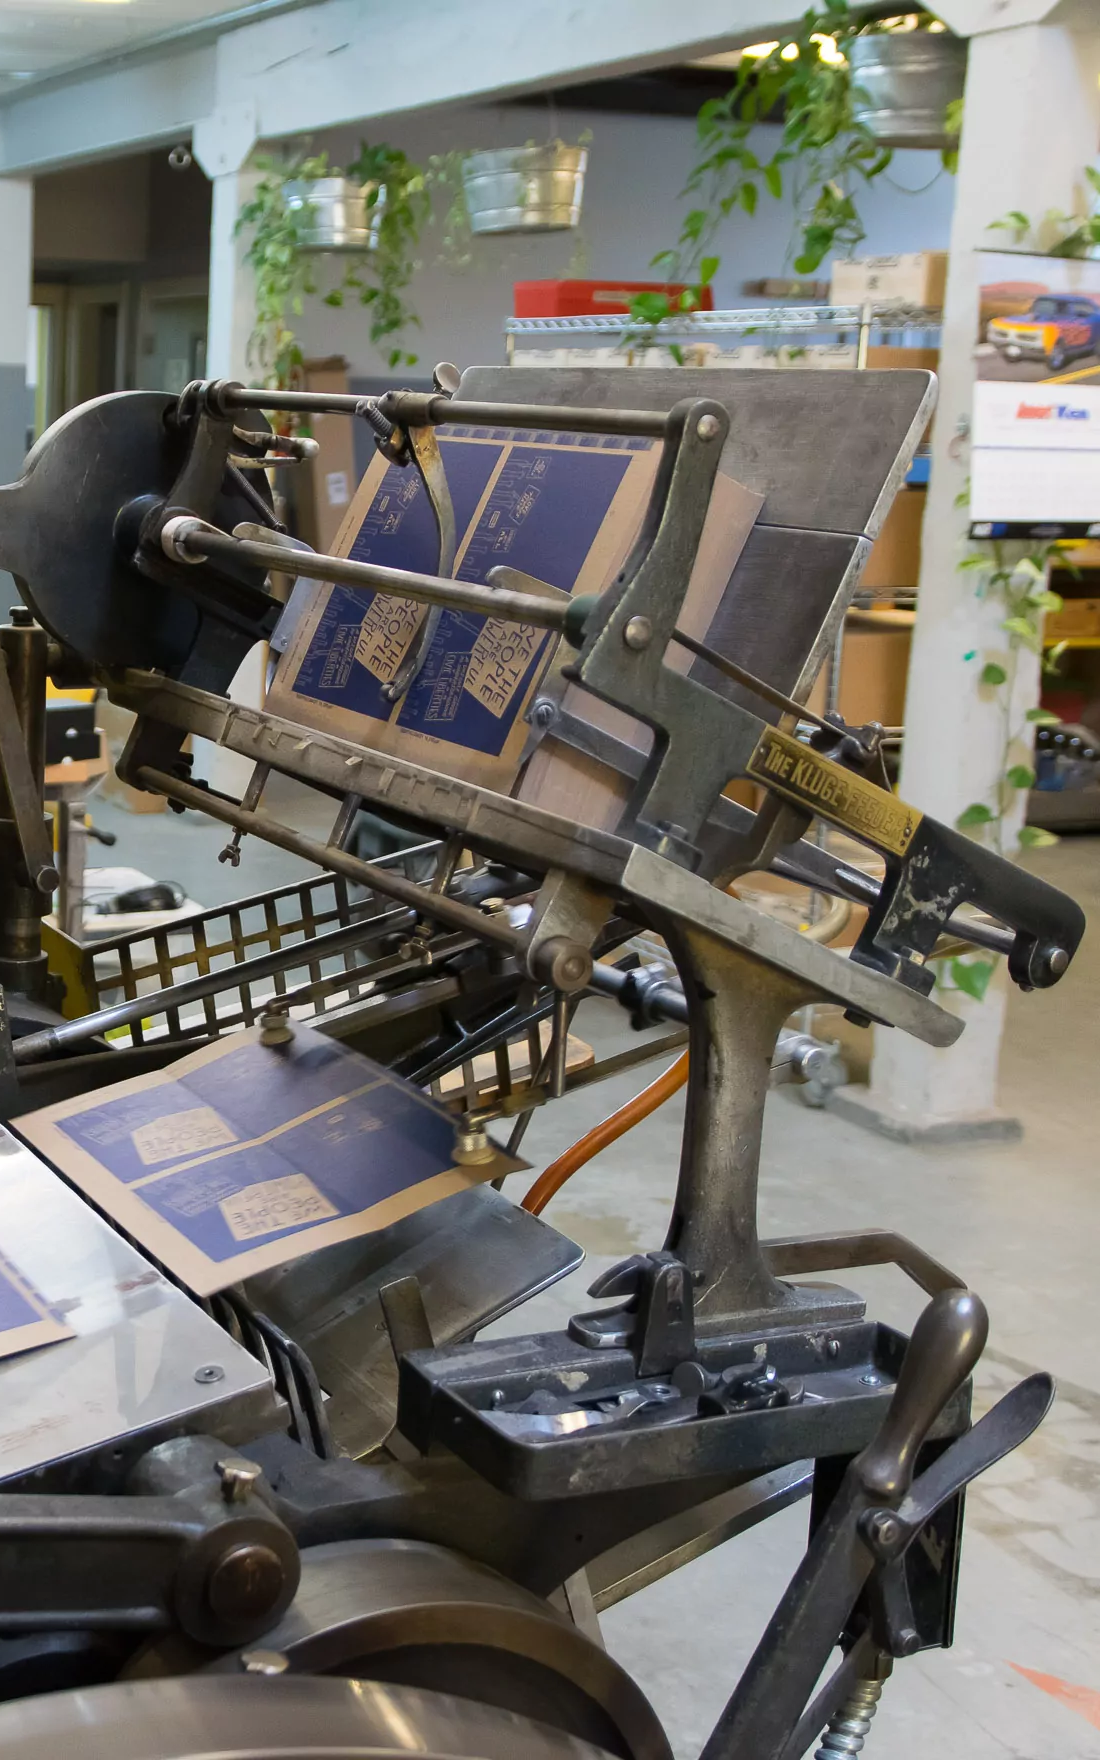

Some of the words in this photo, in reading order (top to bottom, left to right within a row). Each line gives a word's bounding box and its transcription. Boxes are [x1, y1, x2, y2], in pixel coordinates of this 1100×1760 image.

[356, 593, 393, 656] WERFUL
[376, 605, 394, 634] ARE
[380, 640, 407, 678] THE
[465, 618, 506, 686] WERFUL
[489, 631, 508, 661] ARE
[491, 668, 522, 709] THE
[790, 759, 849, 806] KLUGE
[843, 788, 905, 839] FEEDER
